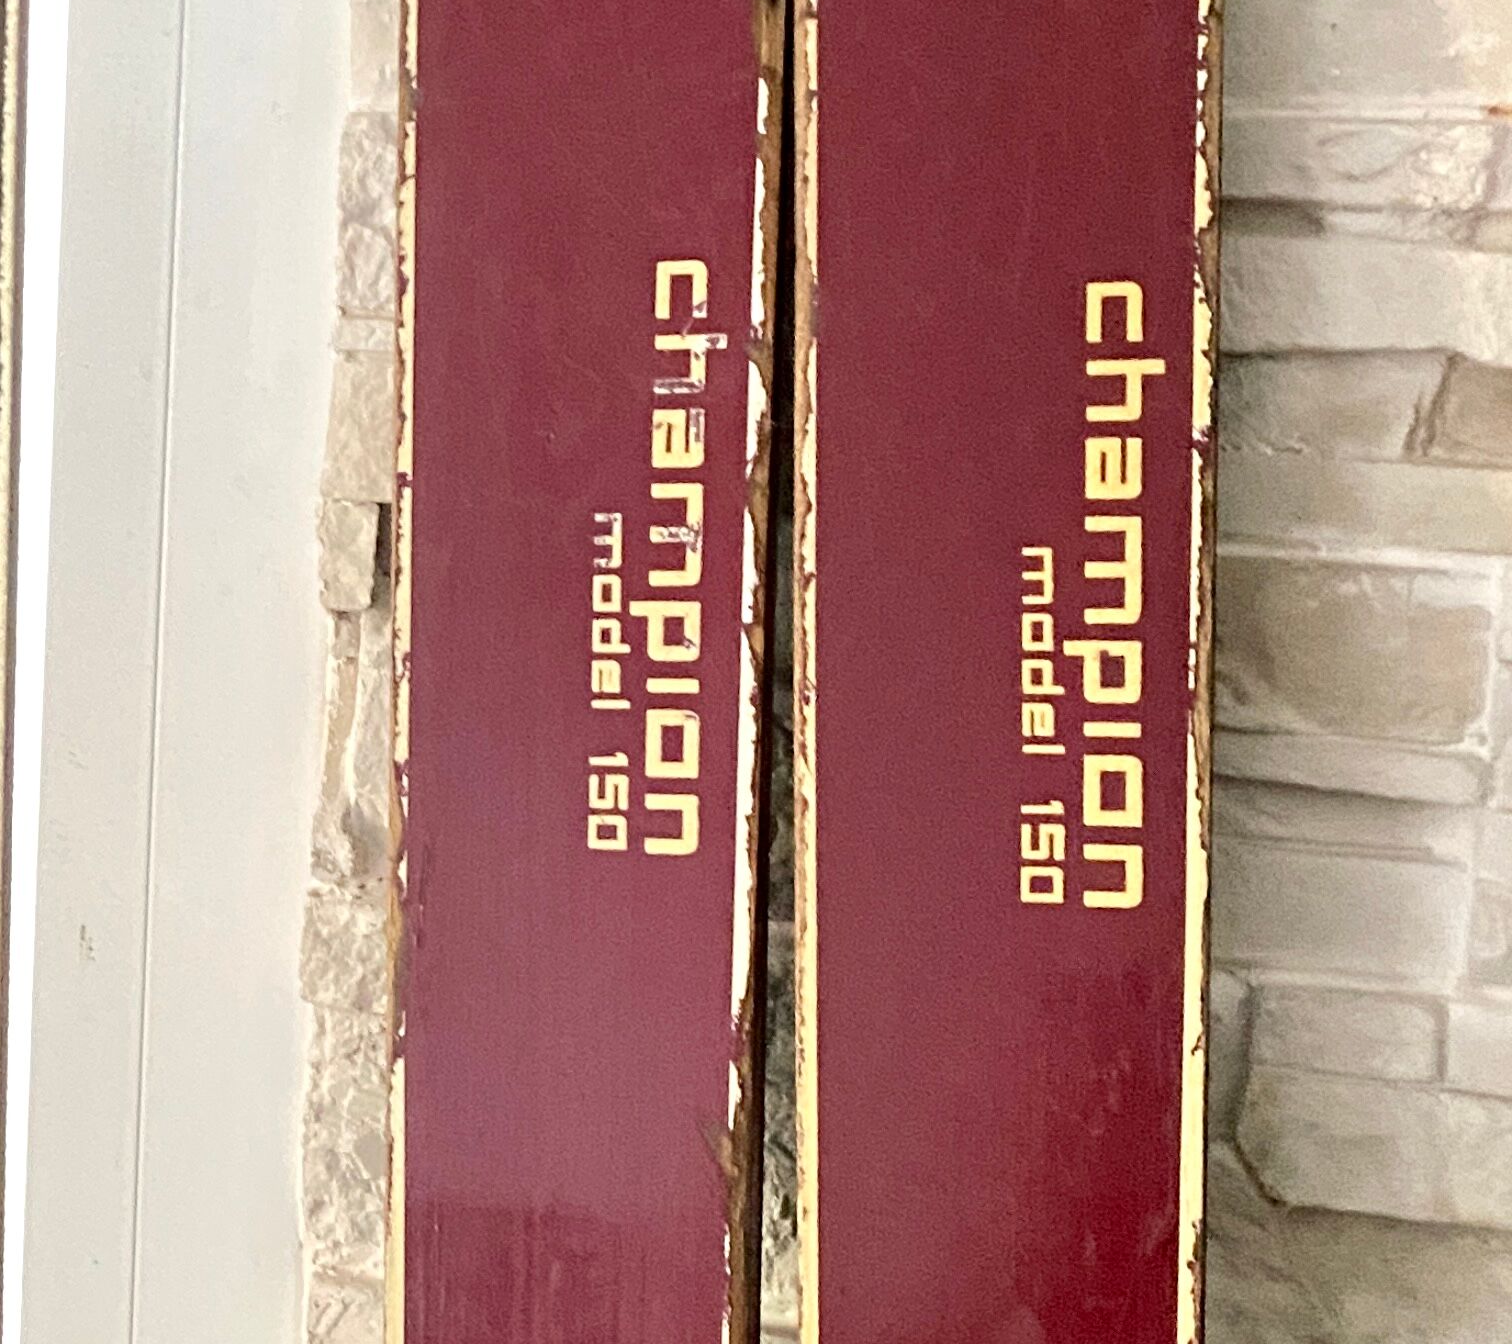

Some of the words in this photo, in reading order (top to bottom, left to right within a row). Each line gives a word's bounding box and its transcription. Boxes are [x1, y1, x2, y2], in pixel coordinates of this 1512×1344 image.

[590, 511, 632, 711] model
[629, 259, 728, 857] champion
[1020, 546, 1066, 756] model
[1062, 279, 1166, 909] champion
[587, 751, 630, 852] 150
[1019, 799, 1067, 905] 150
